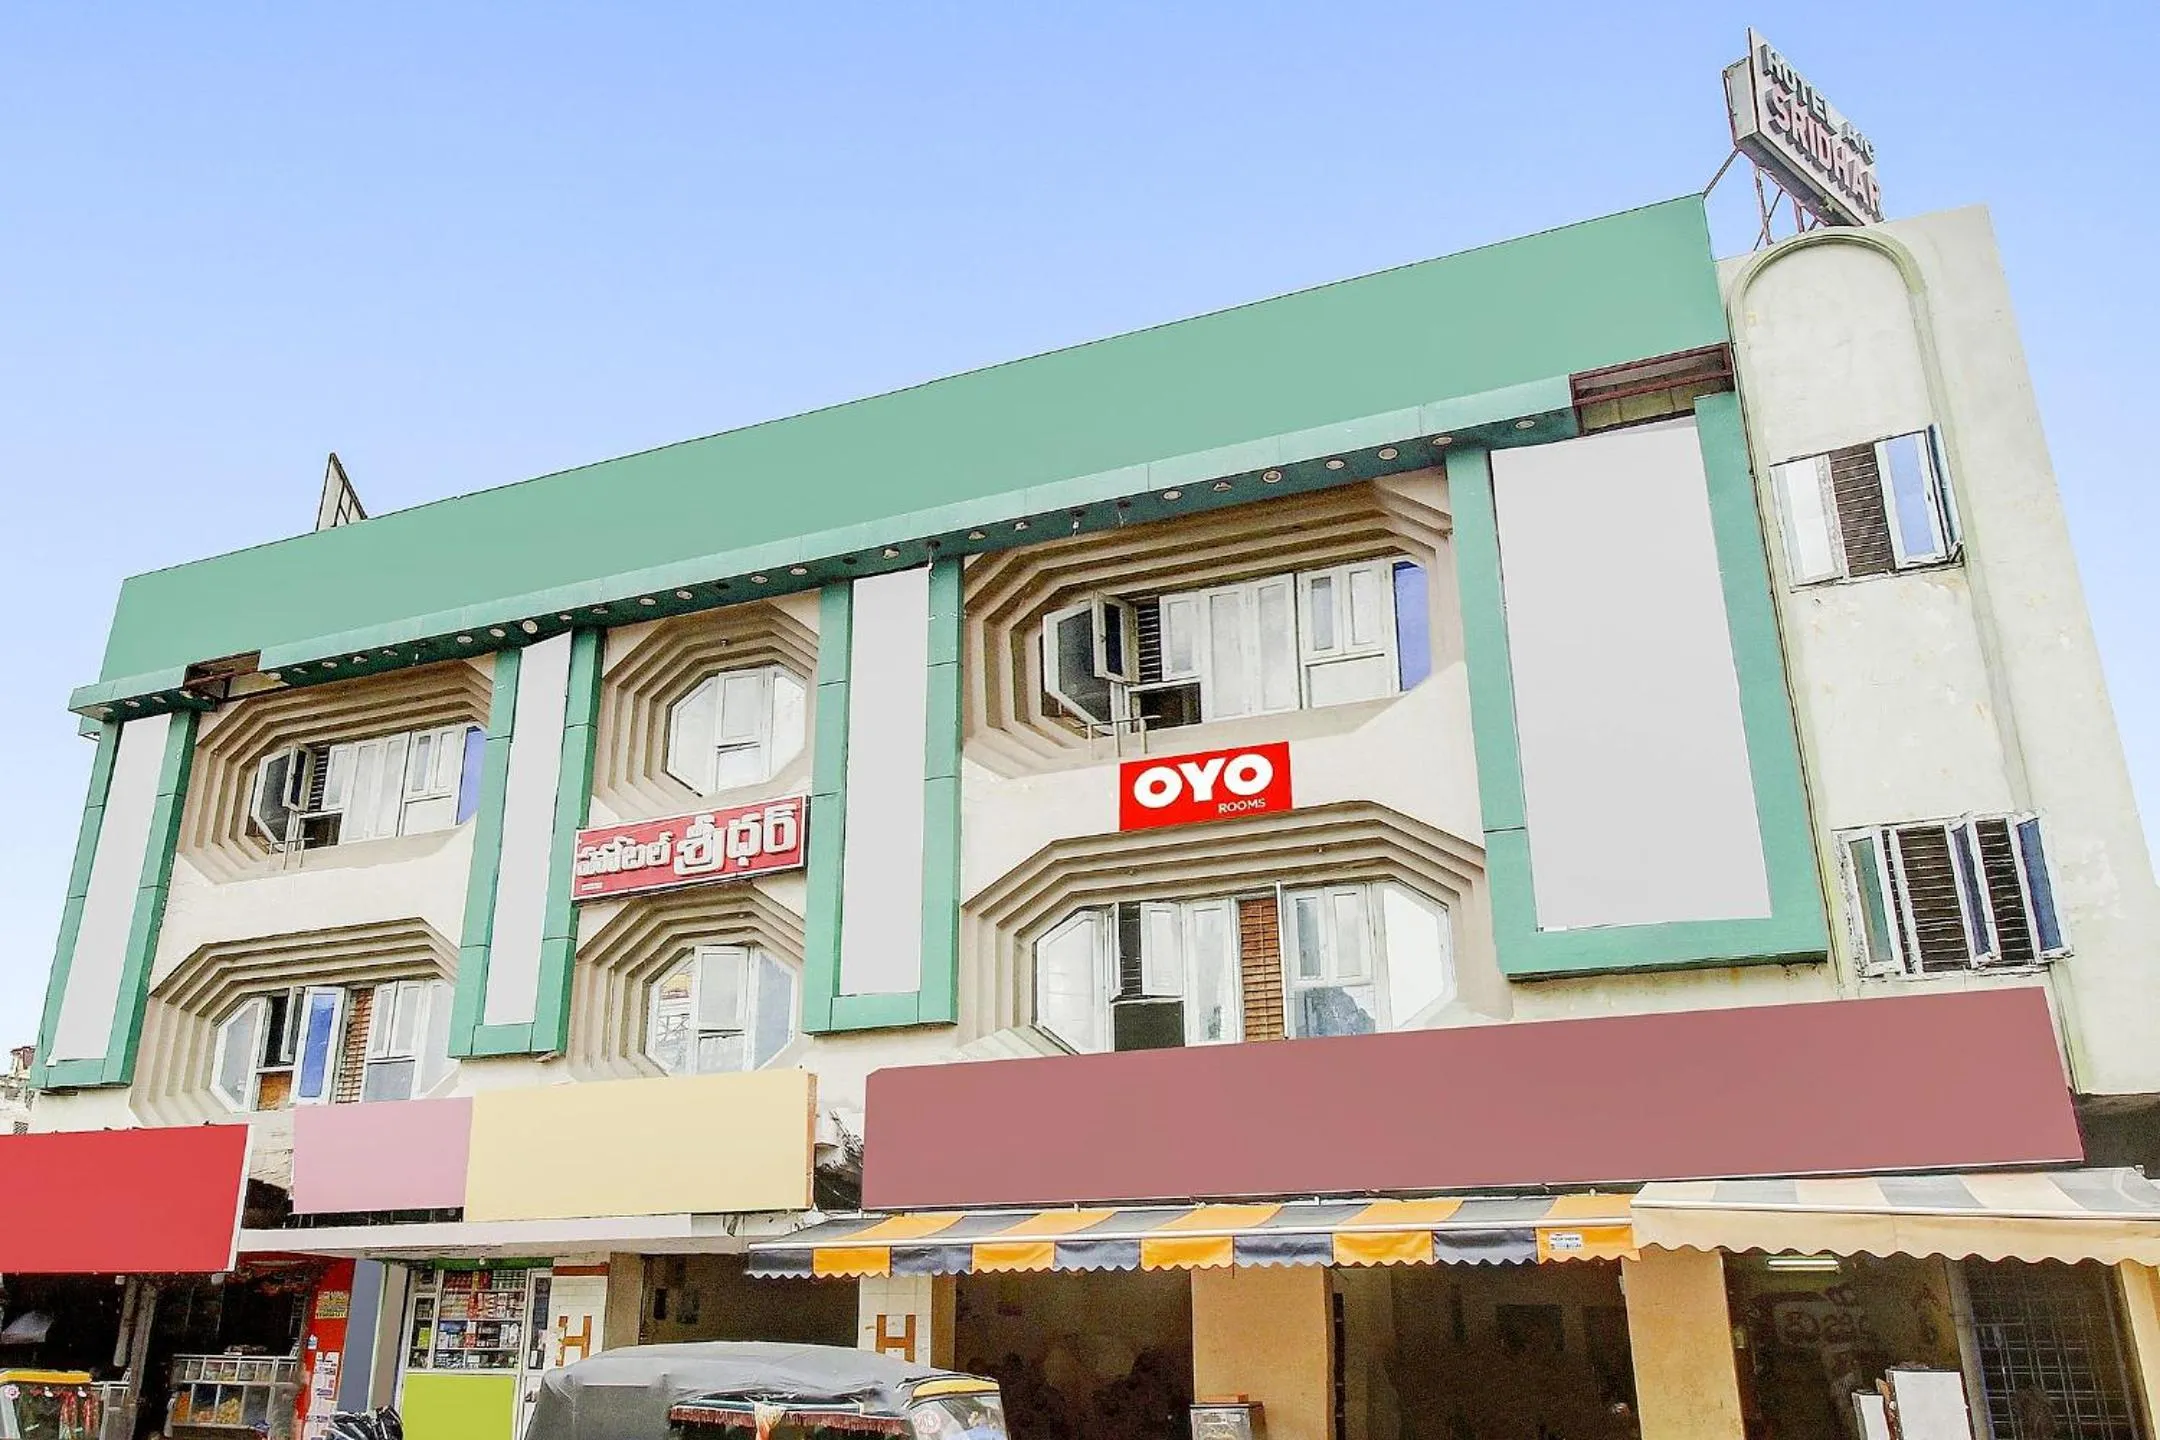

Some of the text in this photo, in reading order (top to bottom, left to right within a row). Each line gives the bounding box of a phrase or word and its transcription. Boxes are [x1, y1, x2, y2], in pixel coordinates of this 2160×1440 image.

[1760, 44, 1837, 136] HOTEL
[1766, 88, 1884, 223] SRIDHAR
[1133, 753, 1274, 809] OYO
[1218, 798, 1266, 814] ROOMS
